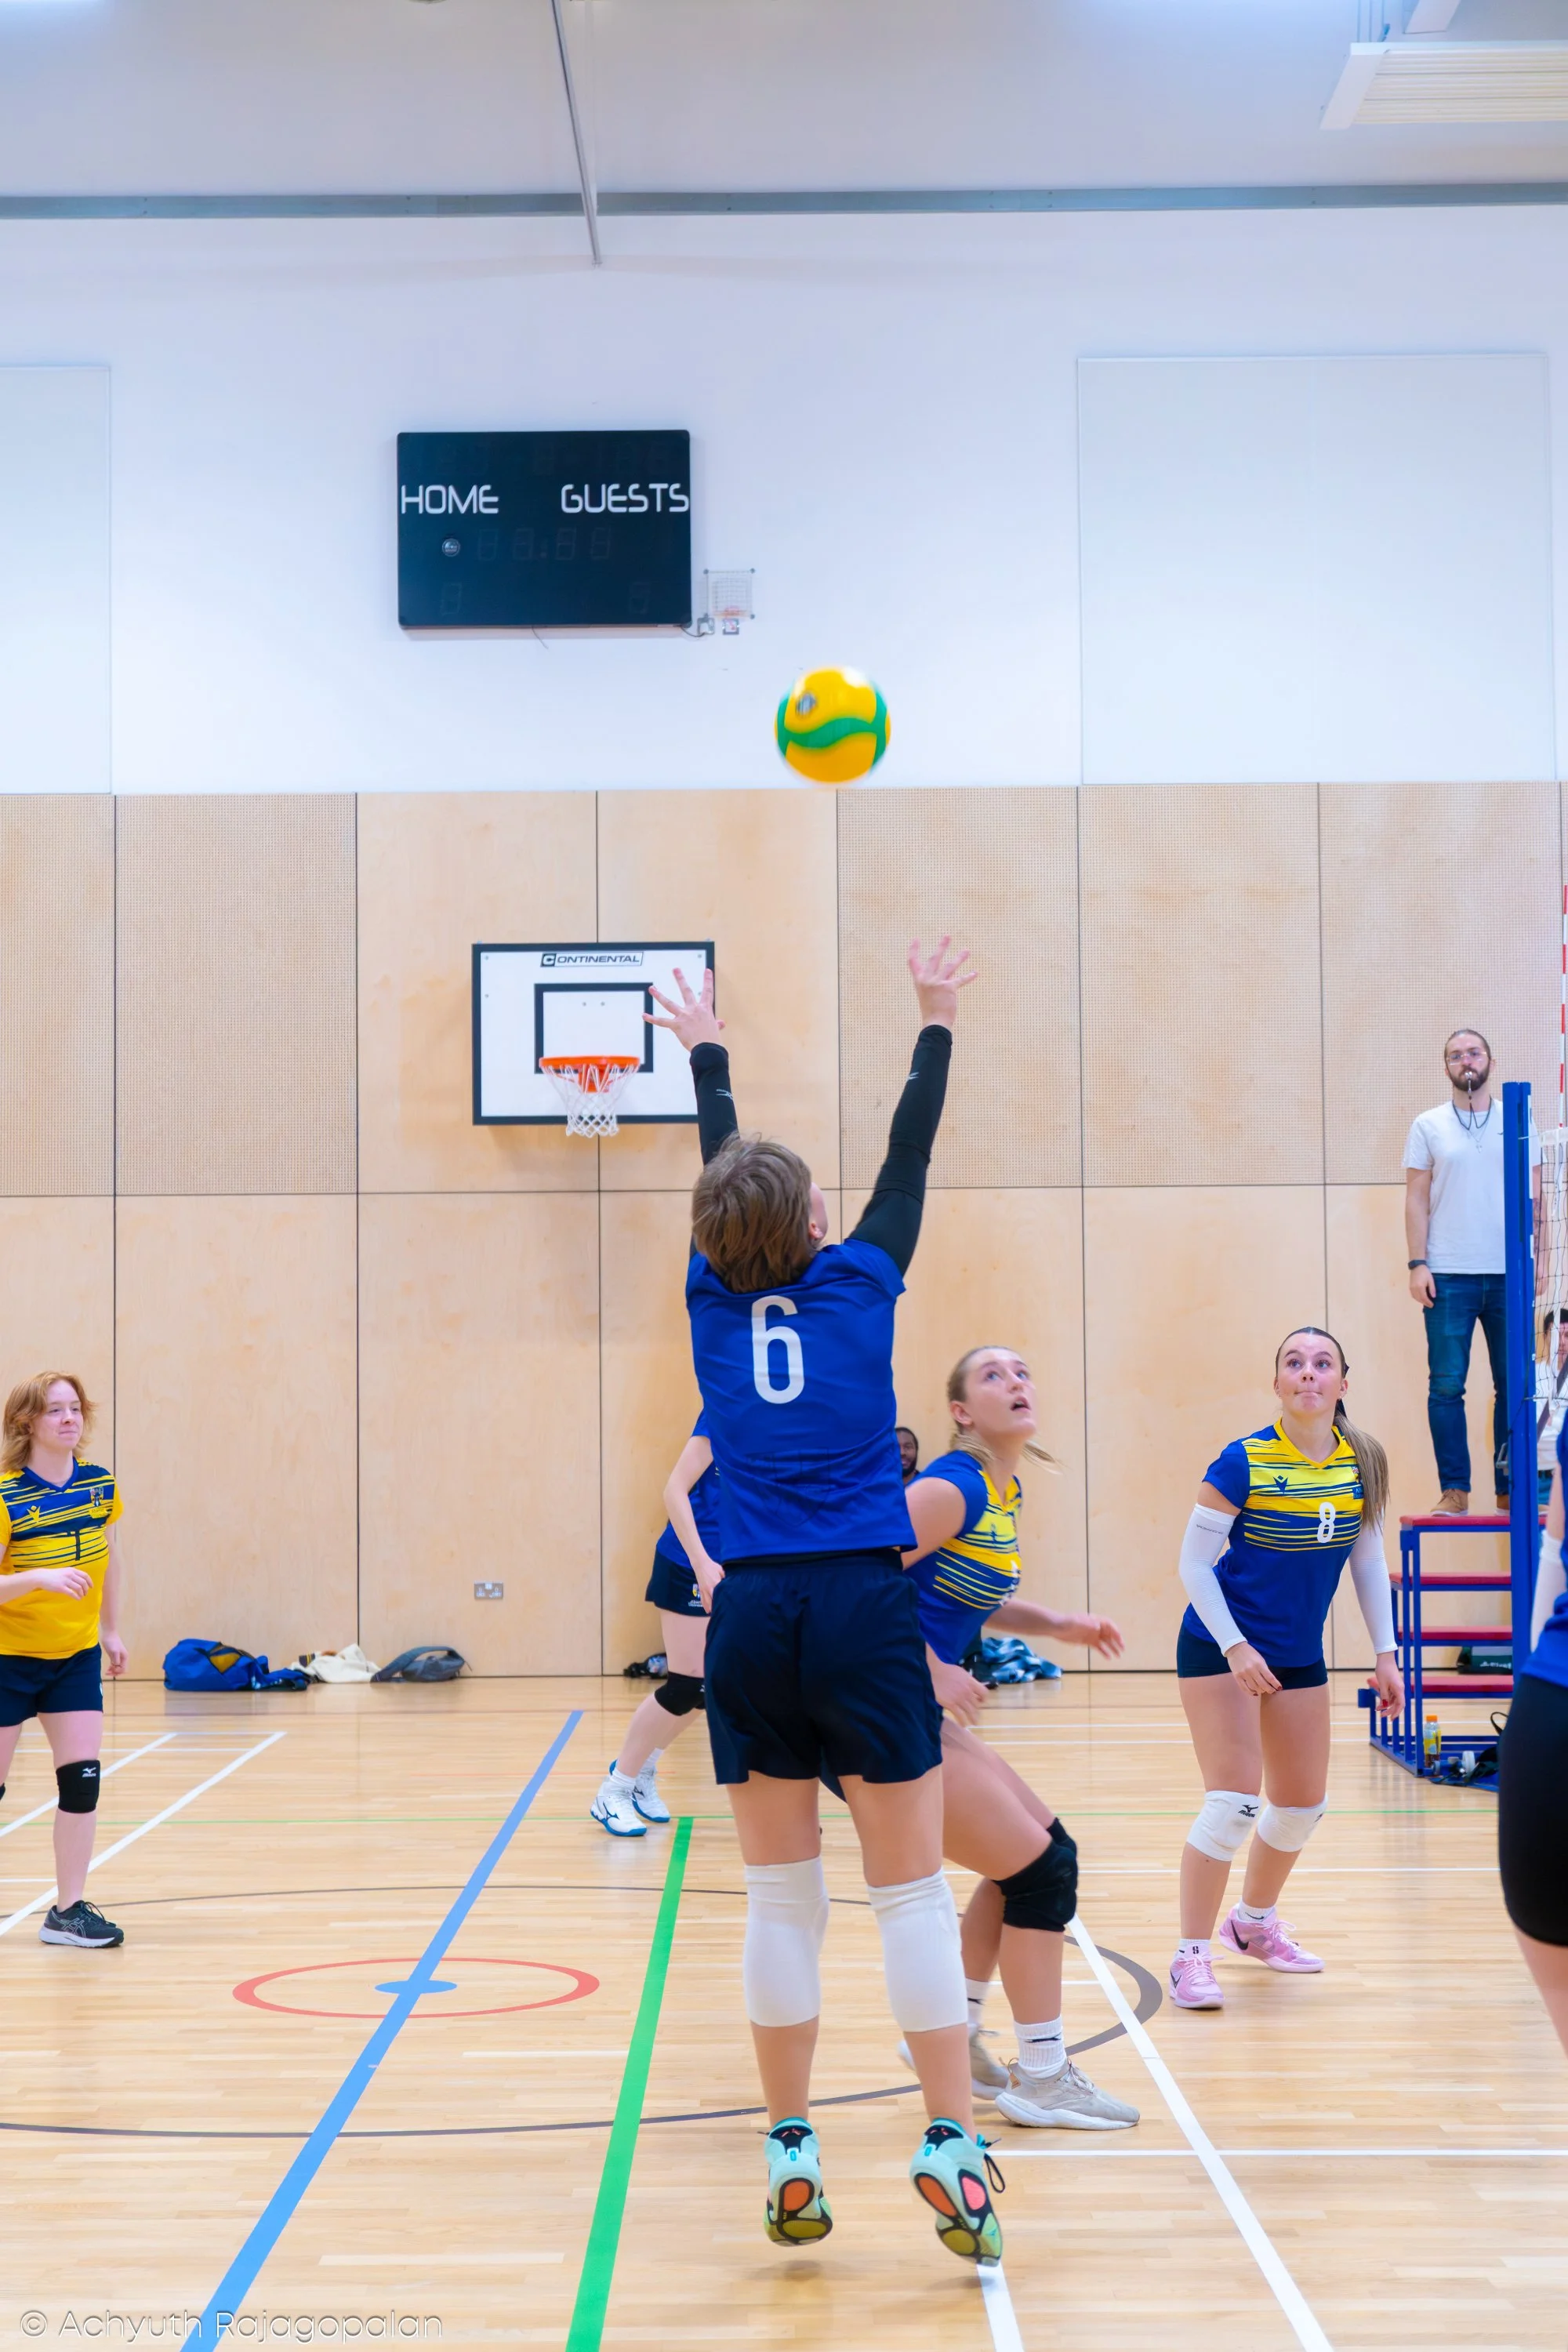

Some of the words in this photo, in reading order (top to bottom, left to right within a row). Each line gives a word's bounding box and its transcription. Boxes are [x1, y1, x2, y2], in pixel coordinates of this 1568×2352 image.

[401, 485, 499, 514] HOME
[561, 483, 690, 514] GUESTS
[542, 953, 641, 966] CONTINENTAL
[751, 1295, 805, 1404] 6
[1317, 1501, 1336, 1544] 8
